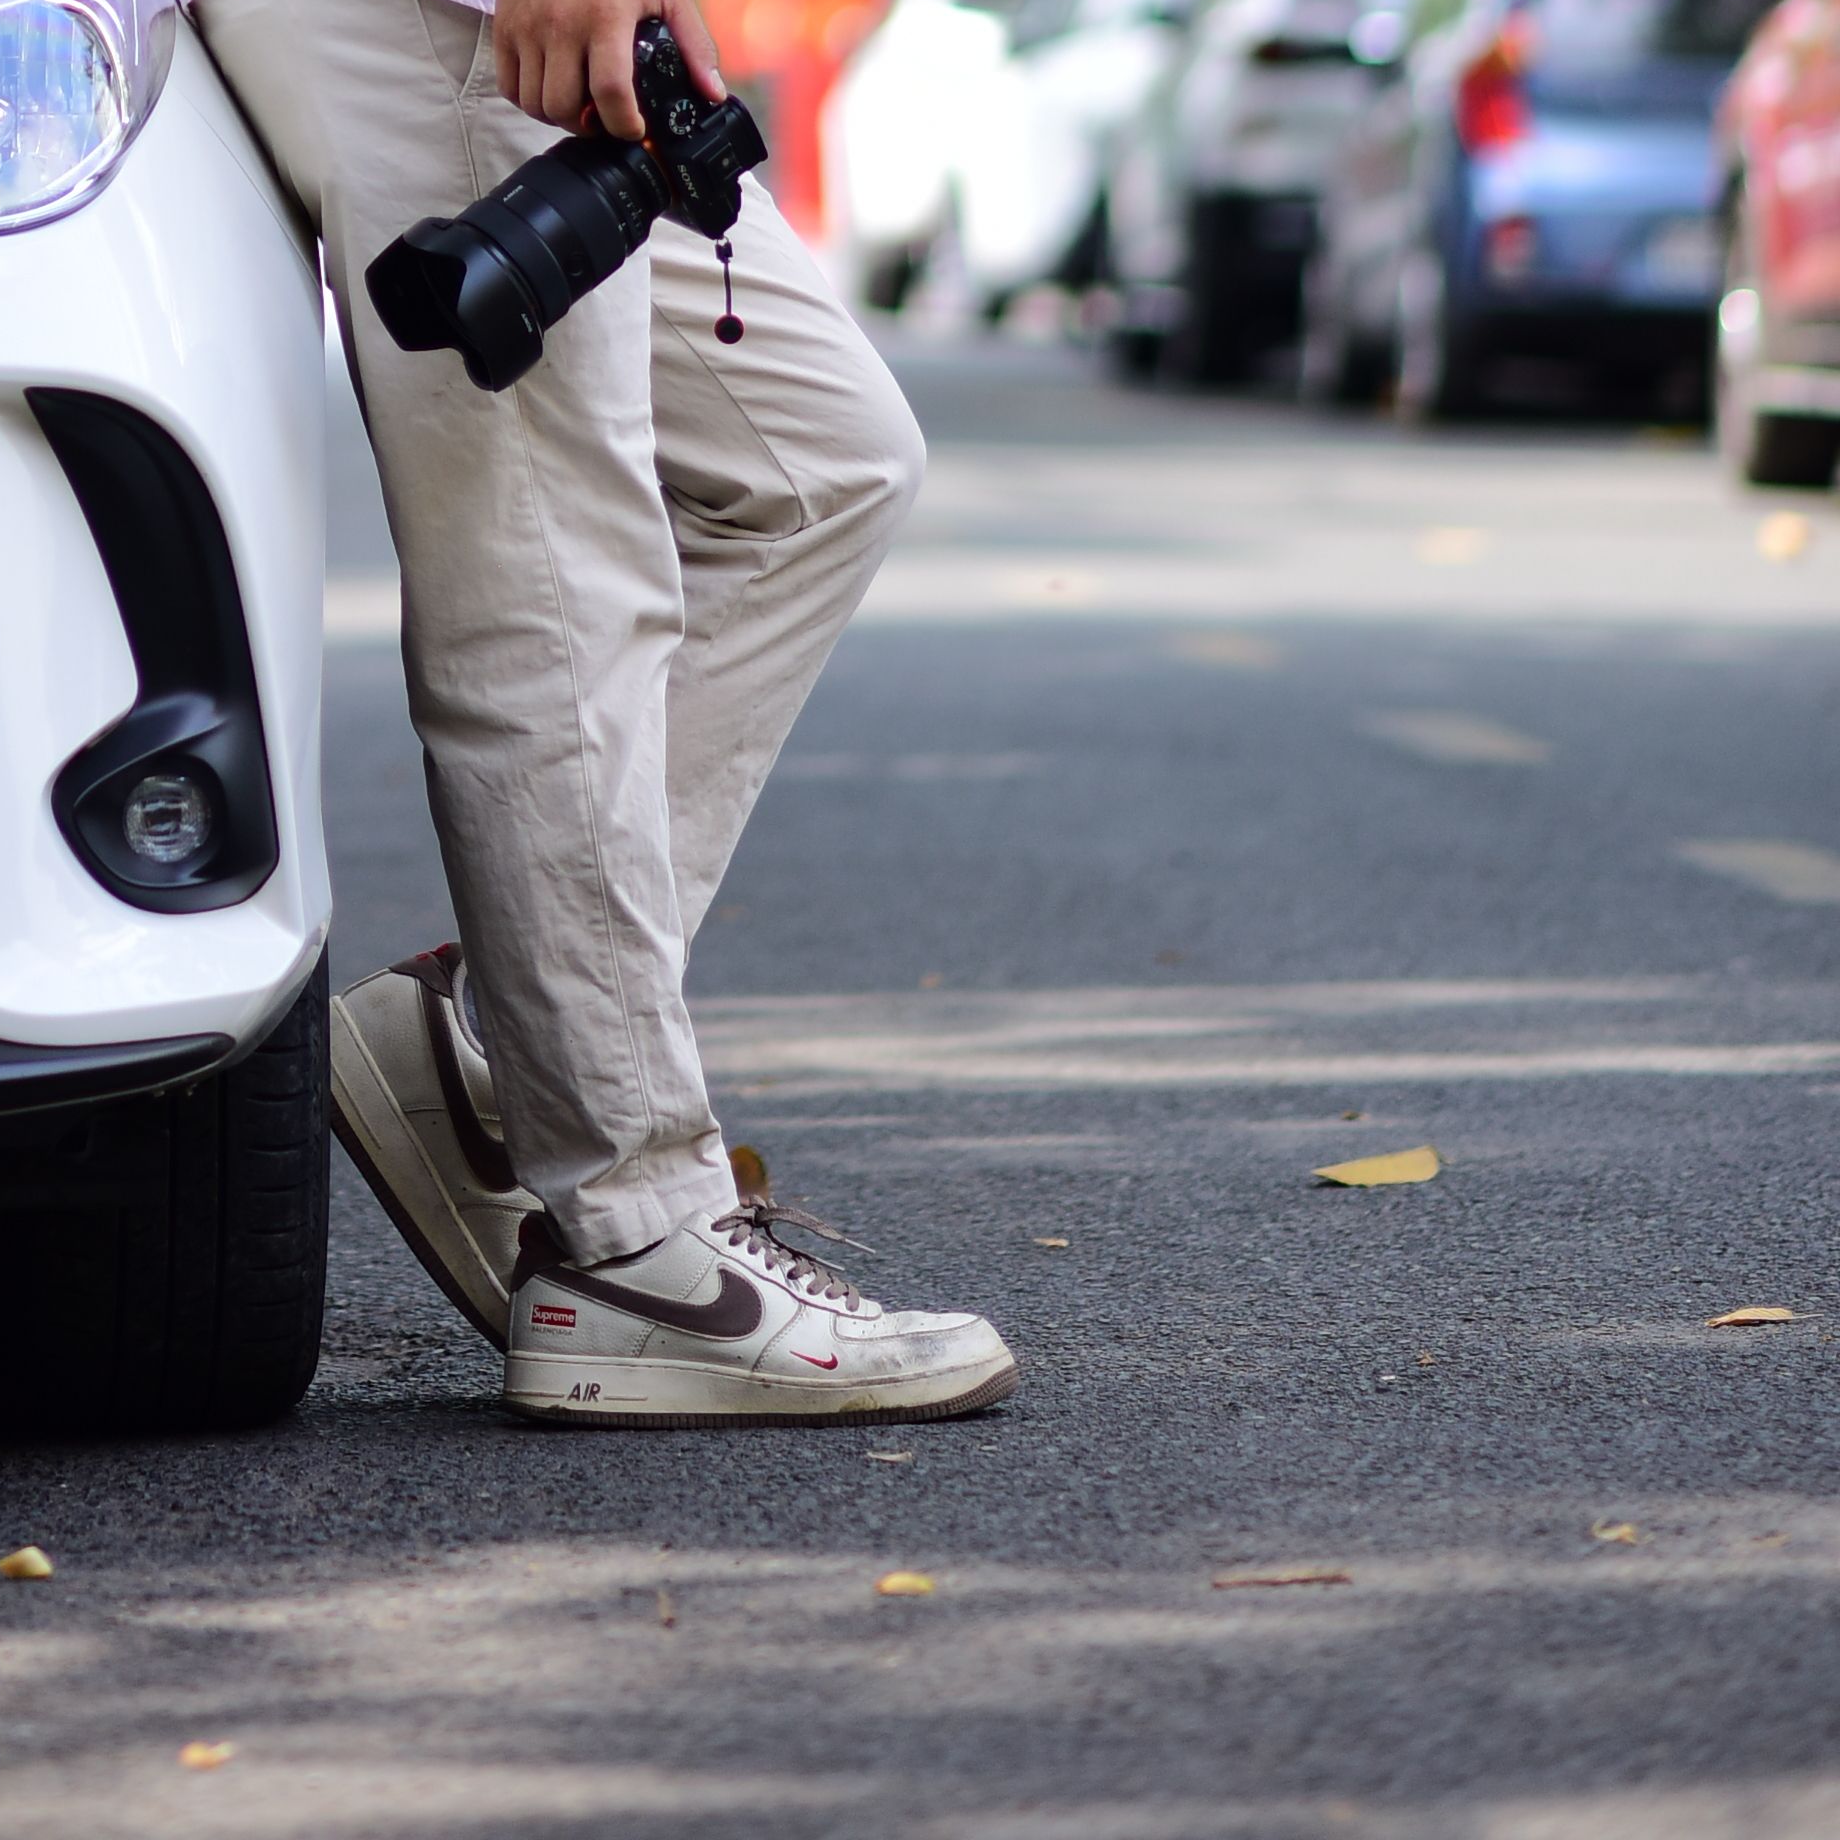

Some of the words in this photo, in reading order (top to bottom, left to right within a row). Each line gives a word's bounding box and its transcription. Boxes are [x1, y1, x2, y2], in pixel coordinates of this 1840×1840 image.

[677, 164, 700, 200] SONY
[533, 1306, 575, 1323] Supreme
[567, 1382, 601, 1402] AIR
